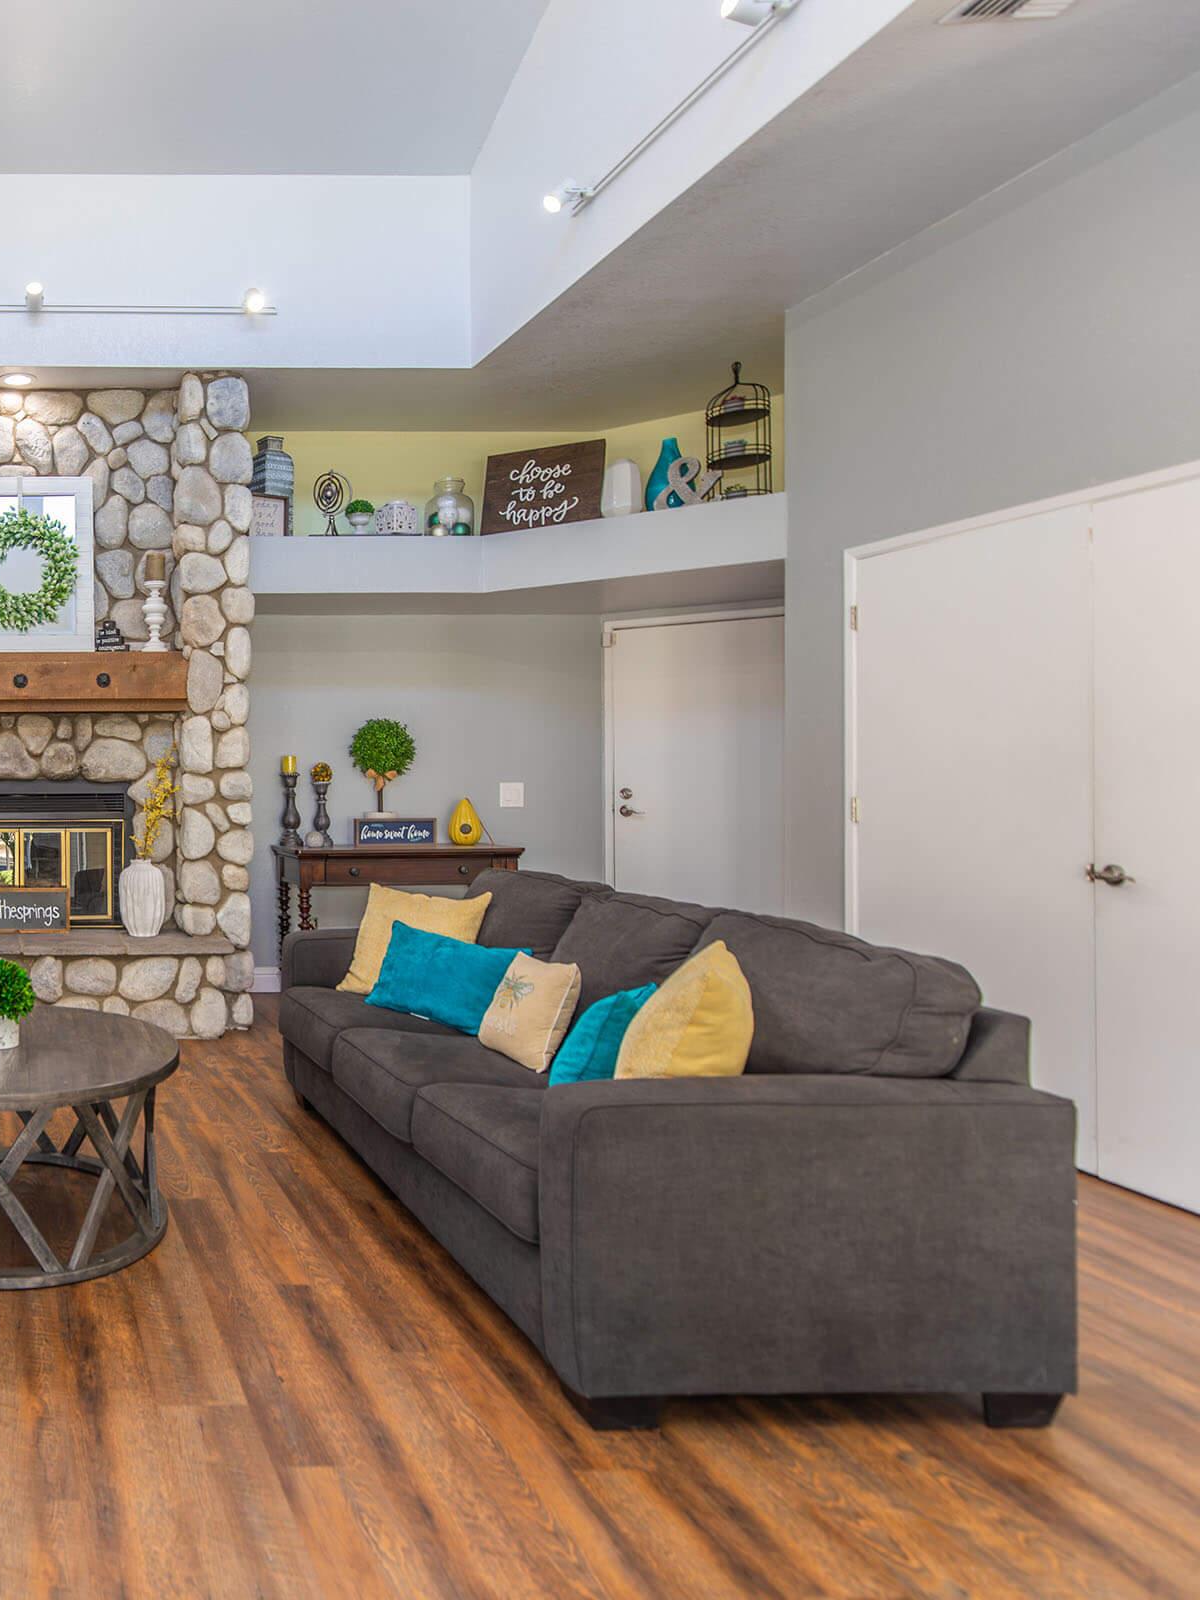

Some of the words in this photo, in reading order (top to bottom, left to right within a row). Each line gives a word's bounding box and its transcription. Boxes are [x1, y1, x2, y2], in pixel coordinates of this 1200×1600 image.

[510, 460, 572, 484] choose
[511, 486, 536, 502] to
[540, 480, 565, 499] be
[499, 497, 579, 528] happy
[360, 824, 384, 841] home
[383, 825, 408, 840] sweet
[407, 824, 430, 840] home
